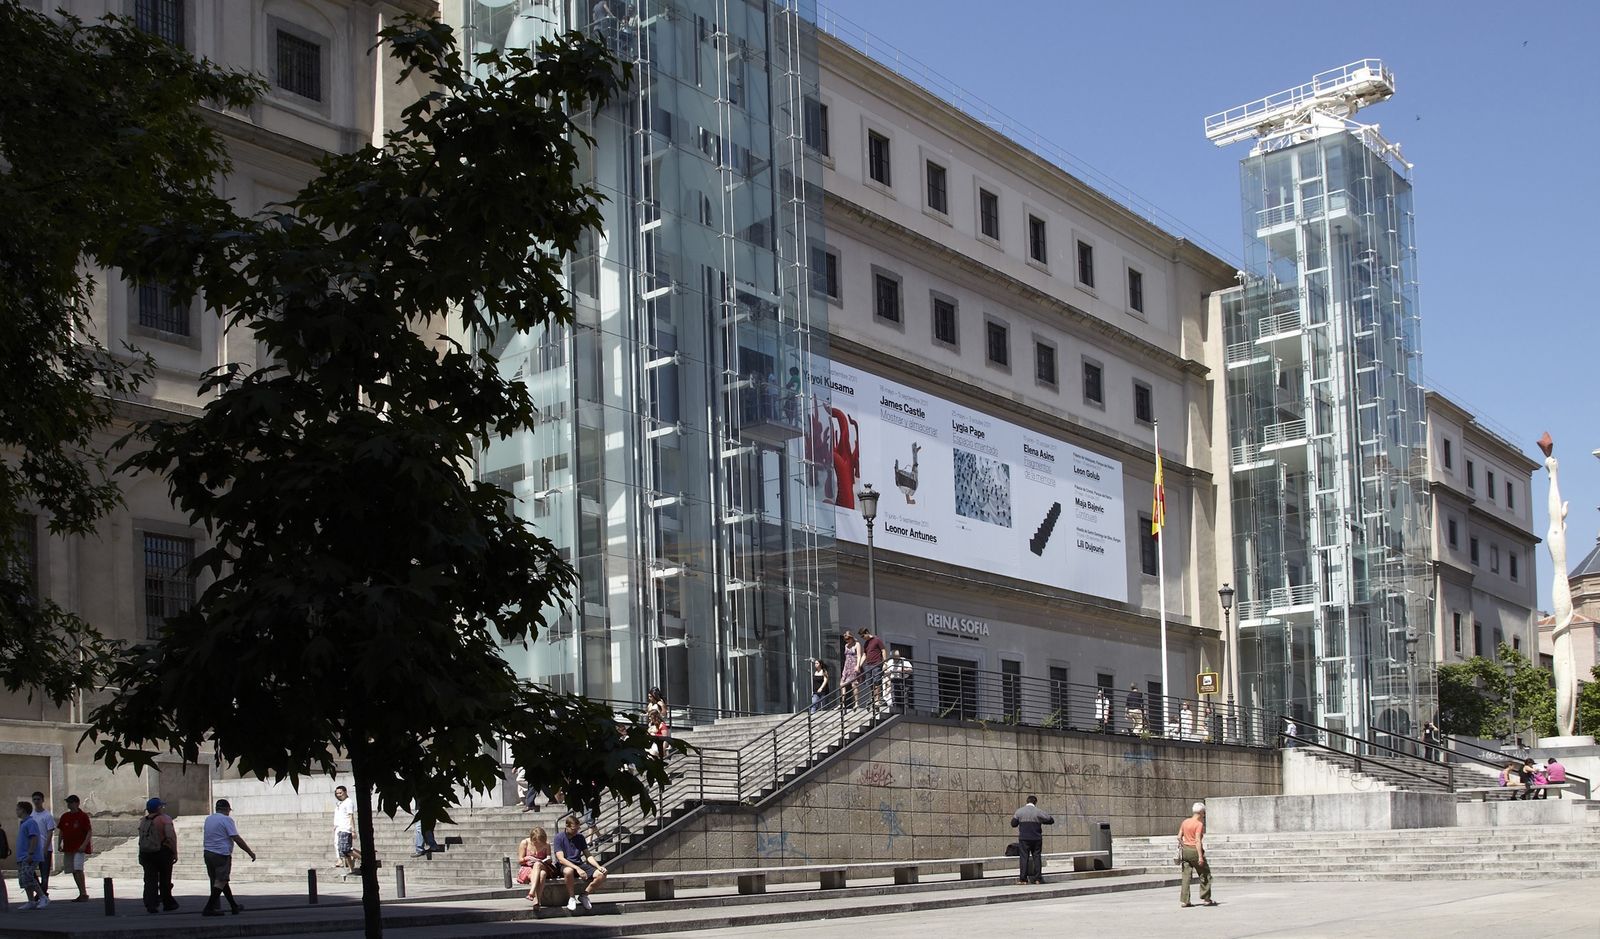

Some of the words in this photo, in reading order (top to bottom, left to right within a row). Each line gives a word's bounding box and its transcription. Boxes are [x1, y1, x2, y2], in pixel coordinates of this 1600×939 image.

[824, 376, 855, 395] Kusama
[880, 395, 903, 411] James
[904, 403, 926, 419] Castle
[880, 408, 904, 424] Mostrar
[952, 419, 969, 434] Lygia
[969, 425, 986, 439] Pape
[1023, 443, 1039, 457] Elena
[1040, 449, 1055, 462] Asins
[1074, 465, 1086, 476] Leon
[1086, 469, 1101, 481] Golub
[1075, 497, 1087, 509] Maja
[885, 521, 909, 536] Leonor
[909, 528, 938, 543] Antunes
[926, 613, 960, 631] REINA
